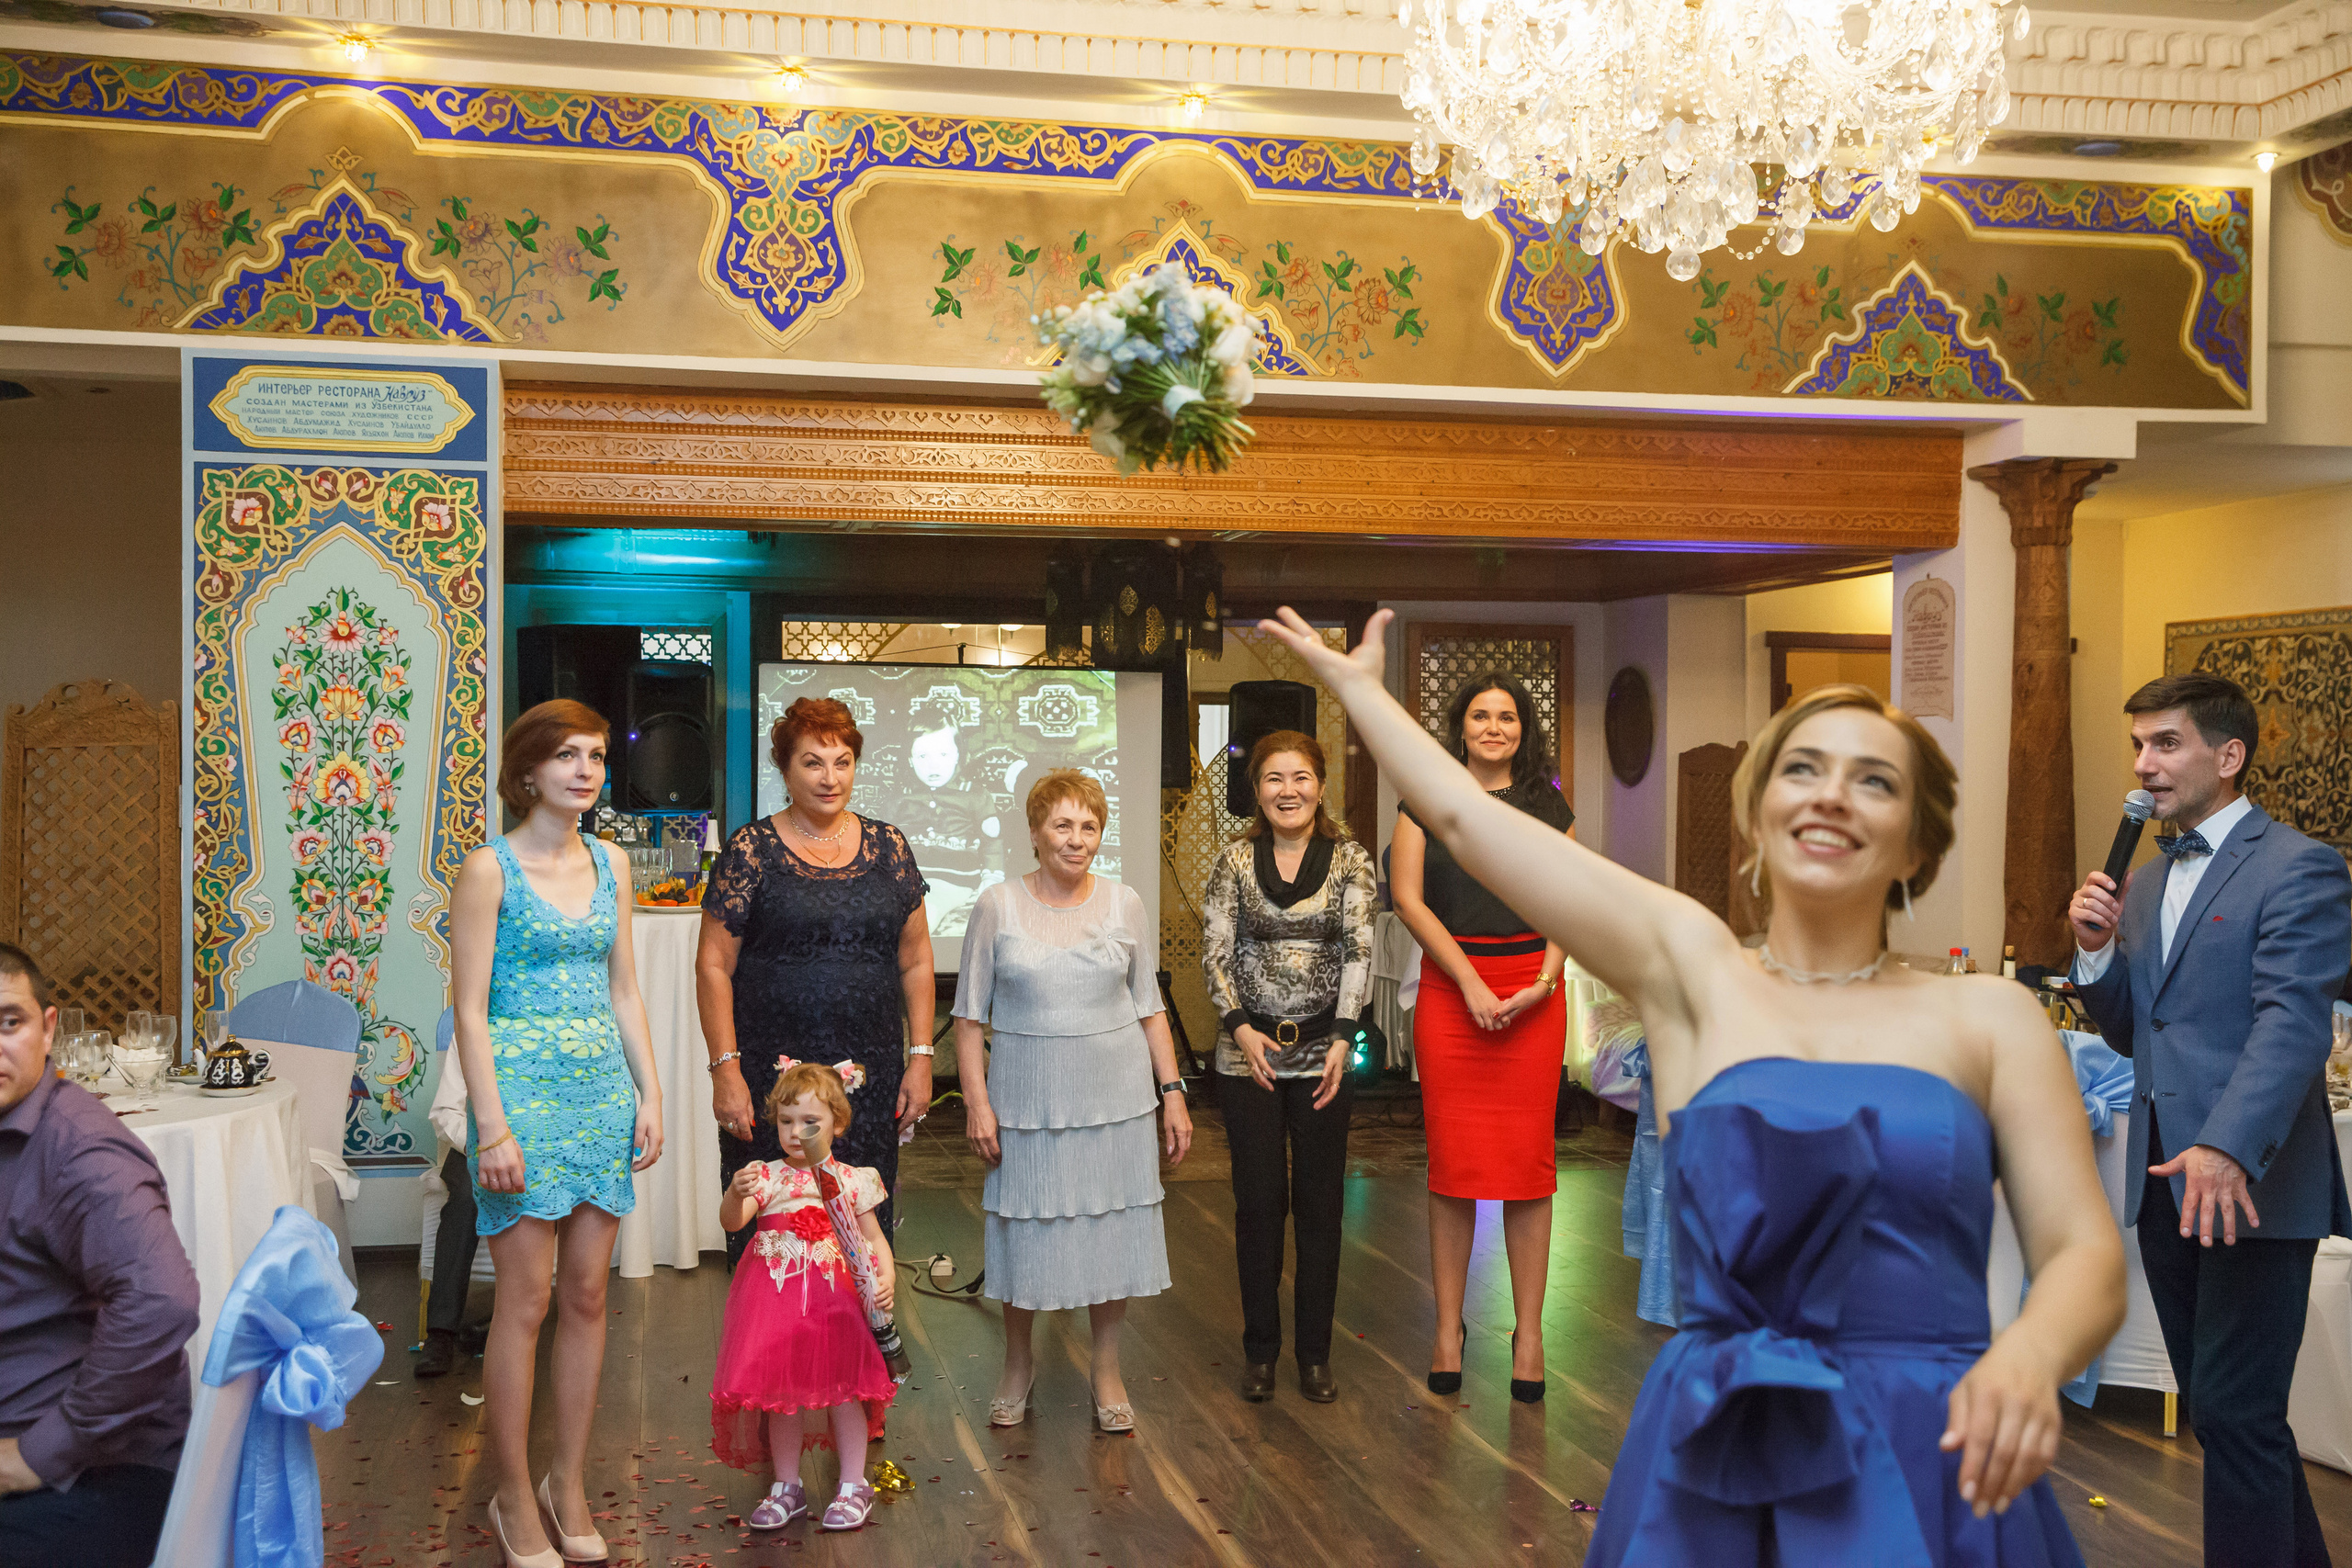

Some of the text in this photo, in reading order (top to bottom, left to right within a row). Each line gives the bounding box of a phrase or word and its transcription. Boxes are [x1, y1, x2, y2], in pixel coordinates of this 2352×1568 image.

[258, 383, 312, 395] ИНТЕРЬЕР
[318, 385, 380, 399] РЕСТОРАНА
[246, 398, 433, 412] СОЗДАН МАСТЕРАМИ ИЗ УЗБЕКИСТАНА
